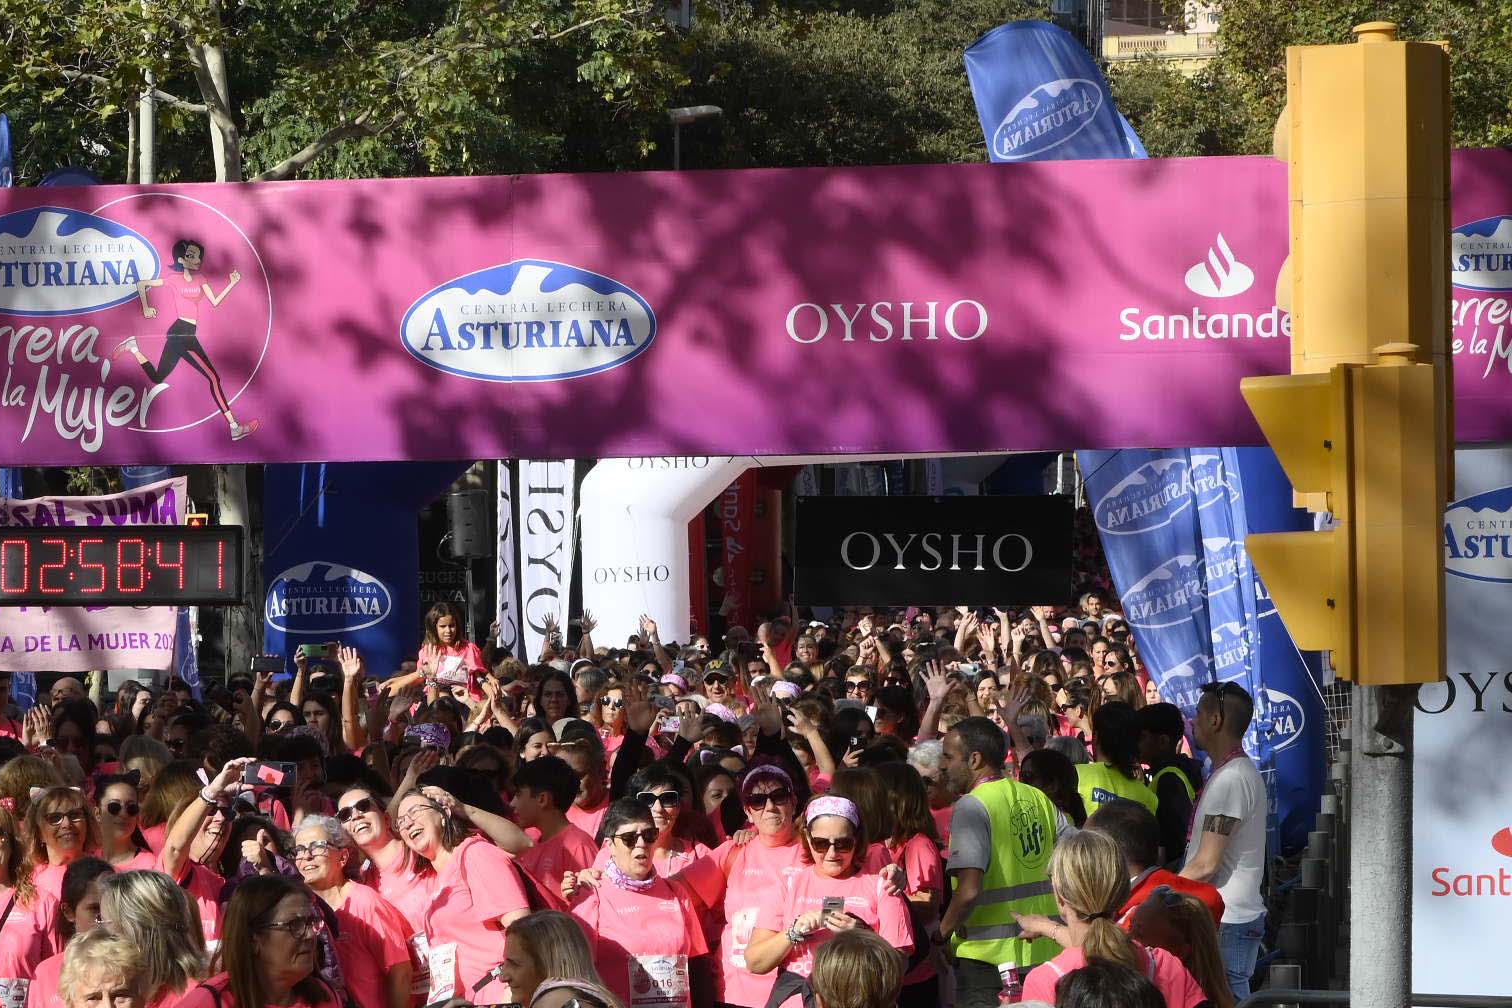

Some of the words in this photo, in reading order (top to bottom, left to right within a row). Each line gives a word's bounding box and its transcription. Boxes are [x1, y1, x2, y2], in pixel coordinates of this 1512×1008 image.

[64, 242, 136, 254] LECHERA
[1451, 254, 1512, 272] STUR
[460, 303, 539, 316] CENTRAL
[547, 300, 628, 313] LECHERA
[786, 299, 988, 344] OYSHO
[1120, 305, 1292, 341] Santande
[420, 308, 636, 352] ASTURIANA
[1, 367, 26, 407] la
[20, 359, 170, 453] Mujer
[85, 487, 179, 528] SUMA
[840, 531, 1033, 572] OYSHO
[594, 565, 670, 584] OYSHO
[269, 590, 381, 618] ASTURIANA
[24, 636, 53, 652] DE
[58, 634, 81, 652] LA
[88, 632, 150, 651] MUJER
